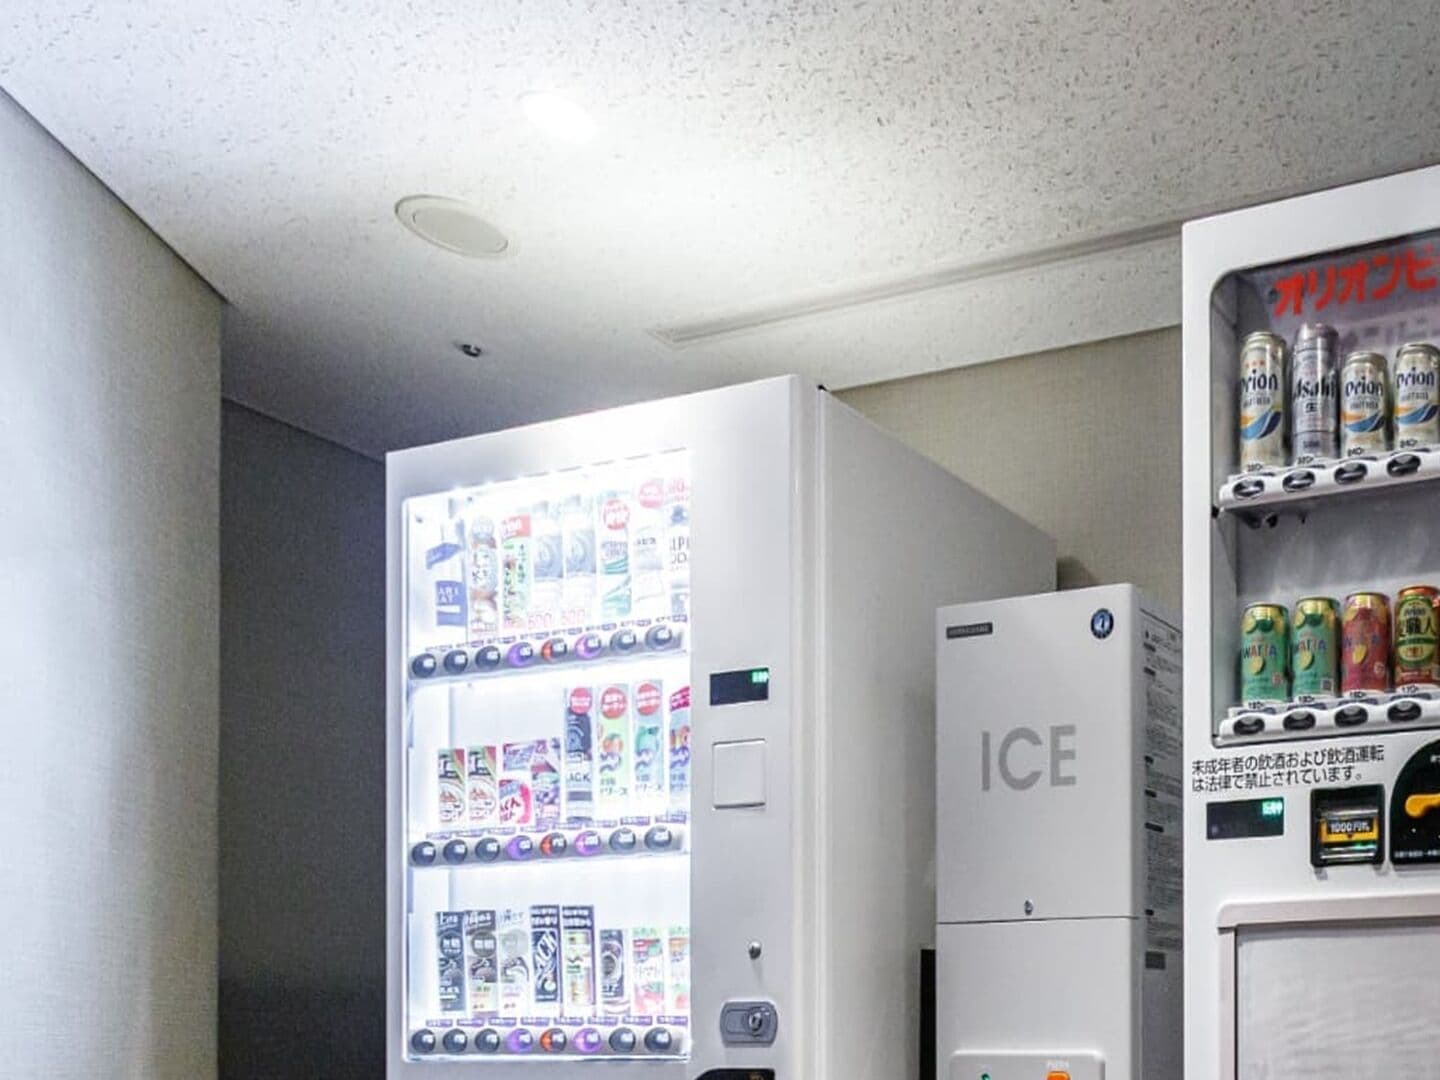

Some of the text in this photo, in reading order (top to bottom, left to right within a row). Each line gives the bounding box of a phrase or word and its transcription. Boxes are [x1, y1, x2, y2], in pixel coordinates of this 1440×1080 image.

[981, 725, 1077, 792] ICE
[1192, 745, 1385, 775] 未成年者の飲酒および飲酒運転
[1192, 767, 1362, 793] は法律で禁止されています。
